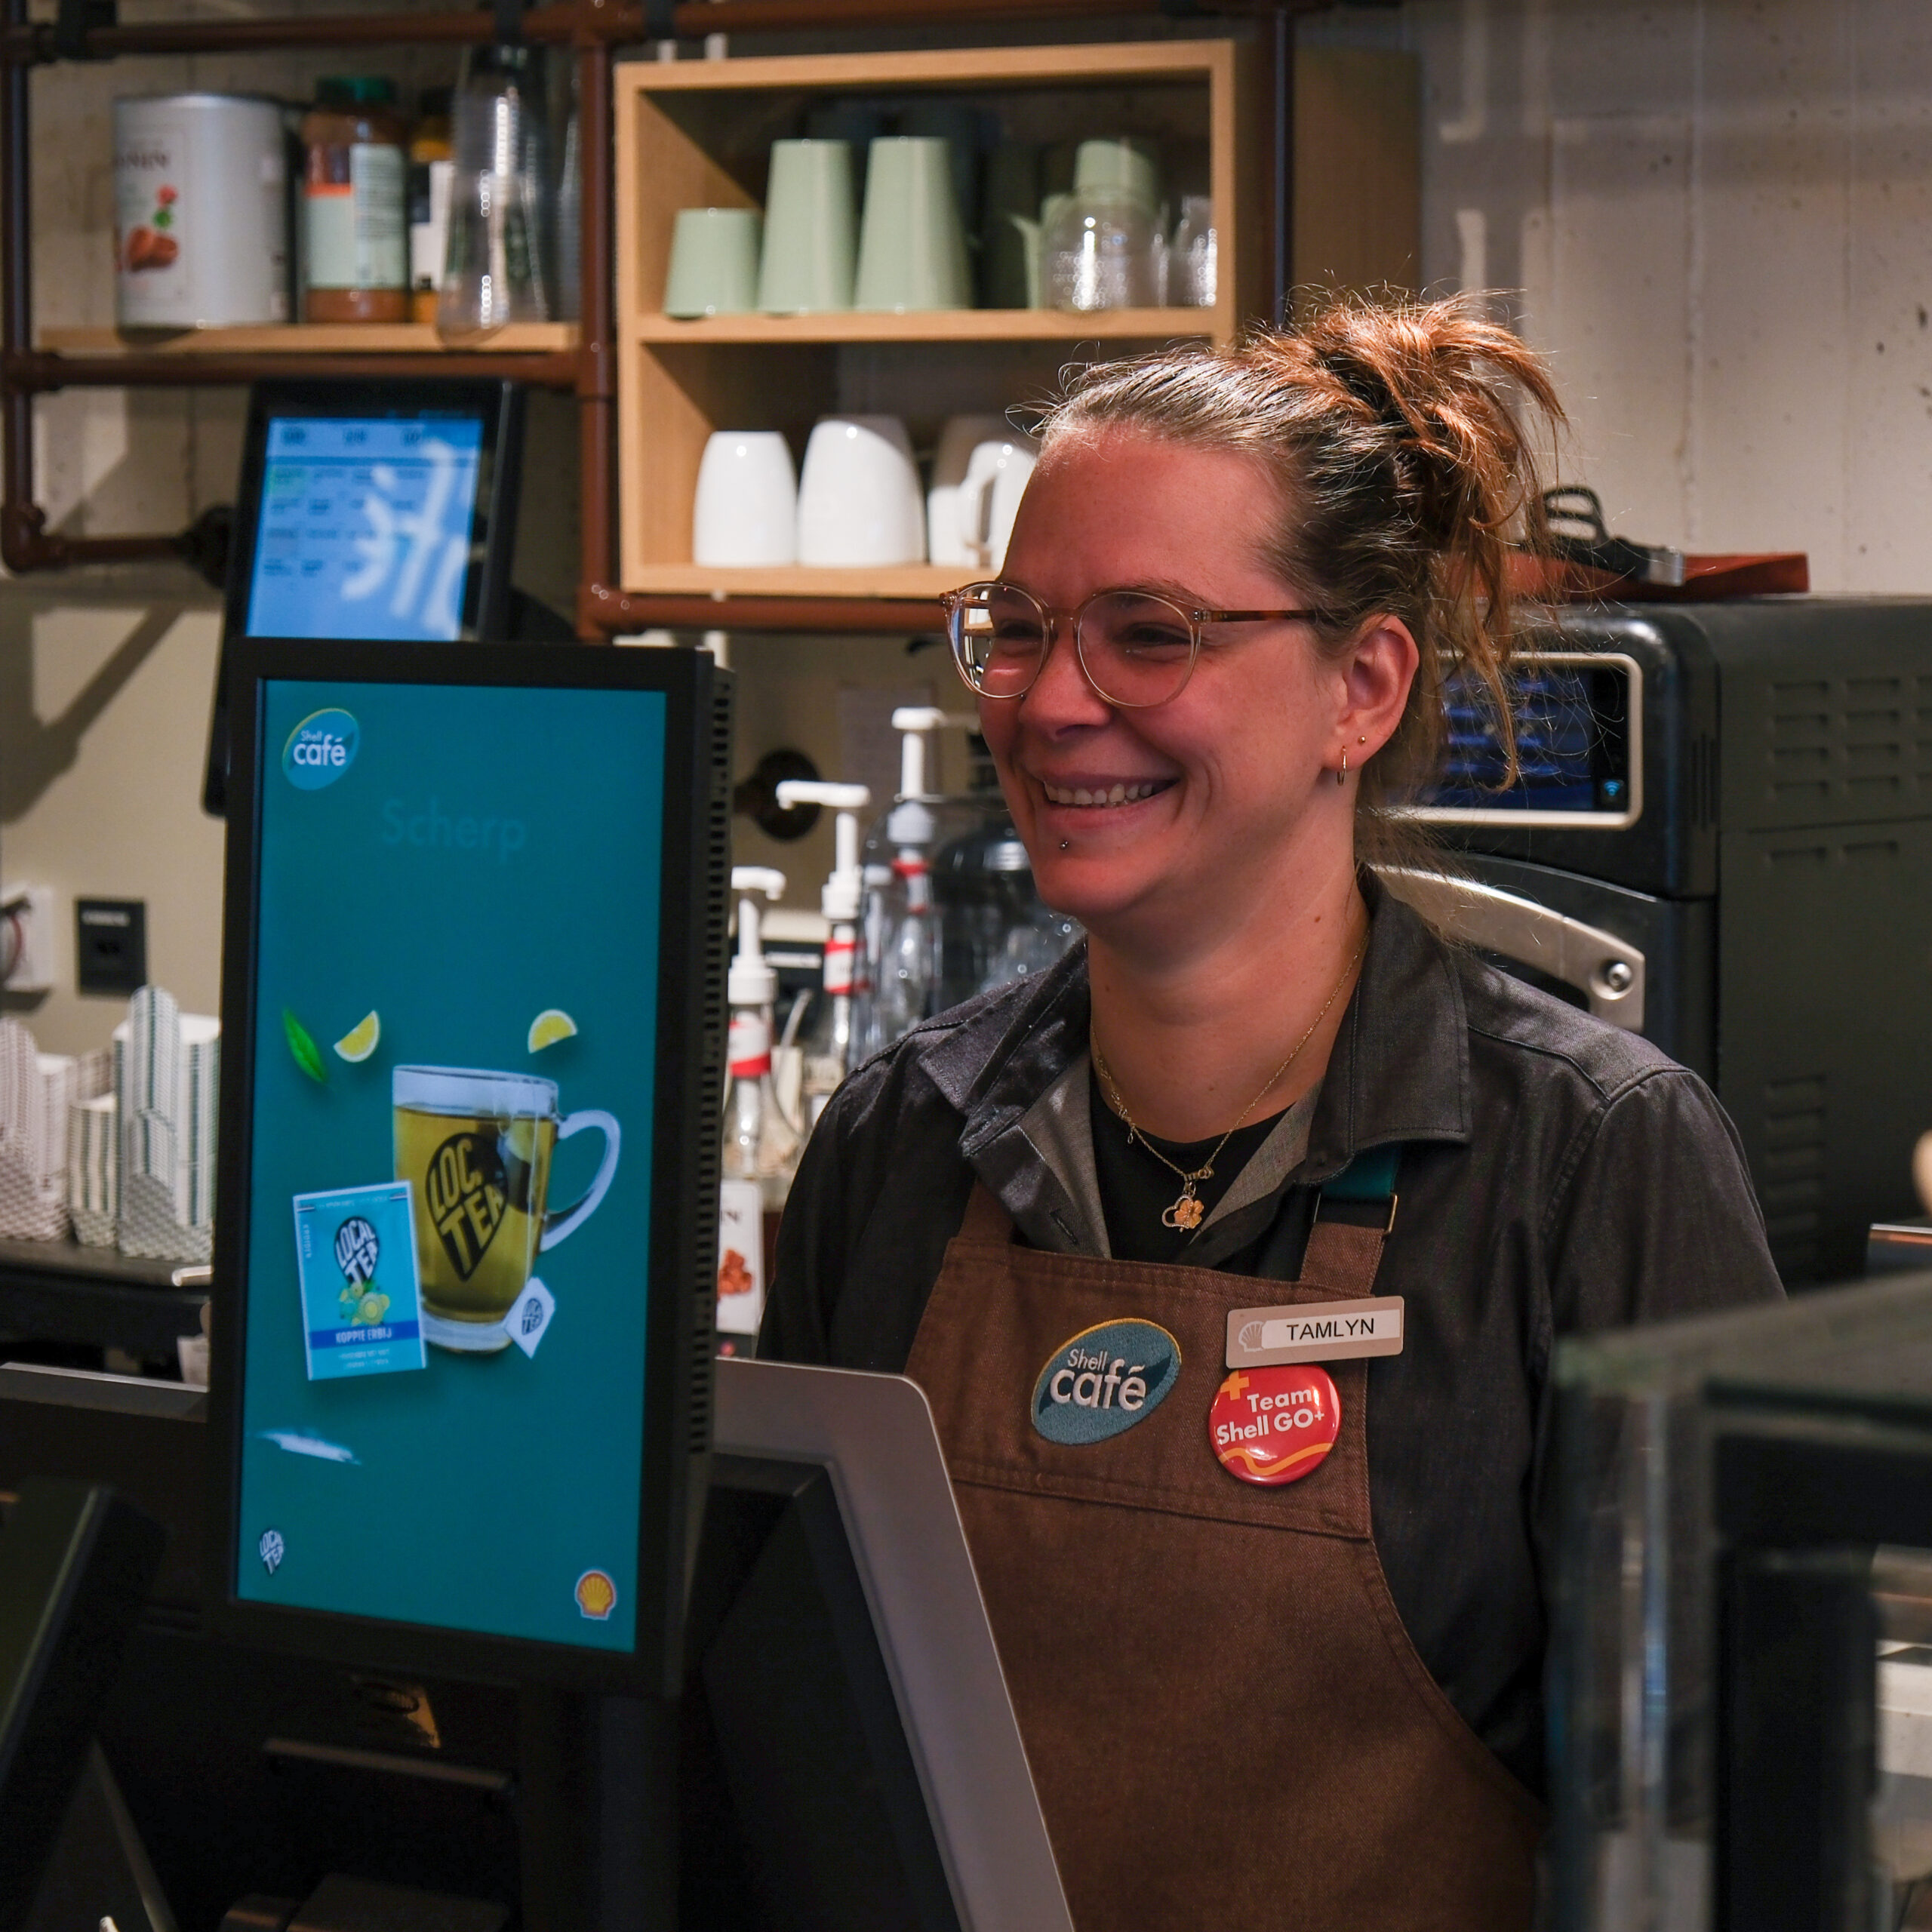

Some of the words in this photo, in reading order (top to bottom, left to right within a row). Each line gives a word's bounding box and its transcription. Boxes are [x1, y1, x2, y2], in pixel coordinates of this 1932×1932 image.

[293, 734, 346, 767] café
[300, 730, 322, 742] Shell
[382, 796, 526, 865] Scherp
[336, 1220, 376, 1269] LOCAL
[439, 1185, 505, 1275] TEA
[344, 1241, 378, 1286] TEA
[335, 1328, 365, 1344] KOPPIE
[1286, 1318, 1375, 1341] TAMLYN
[1067, 1348, 1109, 1371] Shell
[1050, 1358, 1146, 1411] café
[1247, 1389, 1312, 1414] Team
[1217, 1414, 1269, 1445] Shell
[1273, 1408, 1324, 1432] GO+
